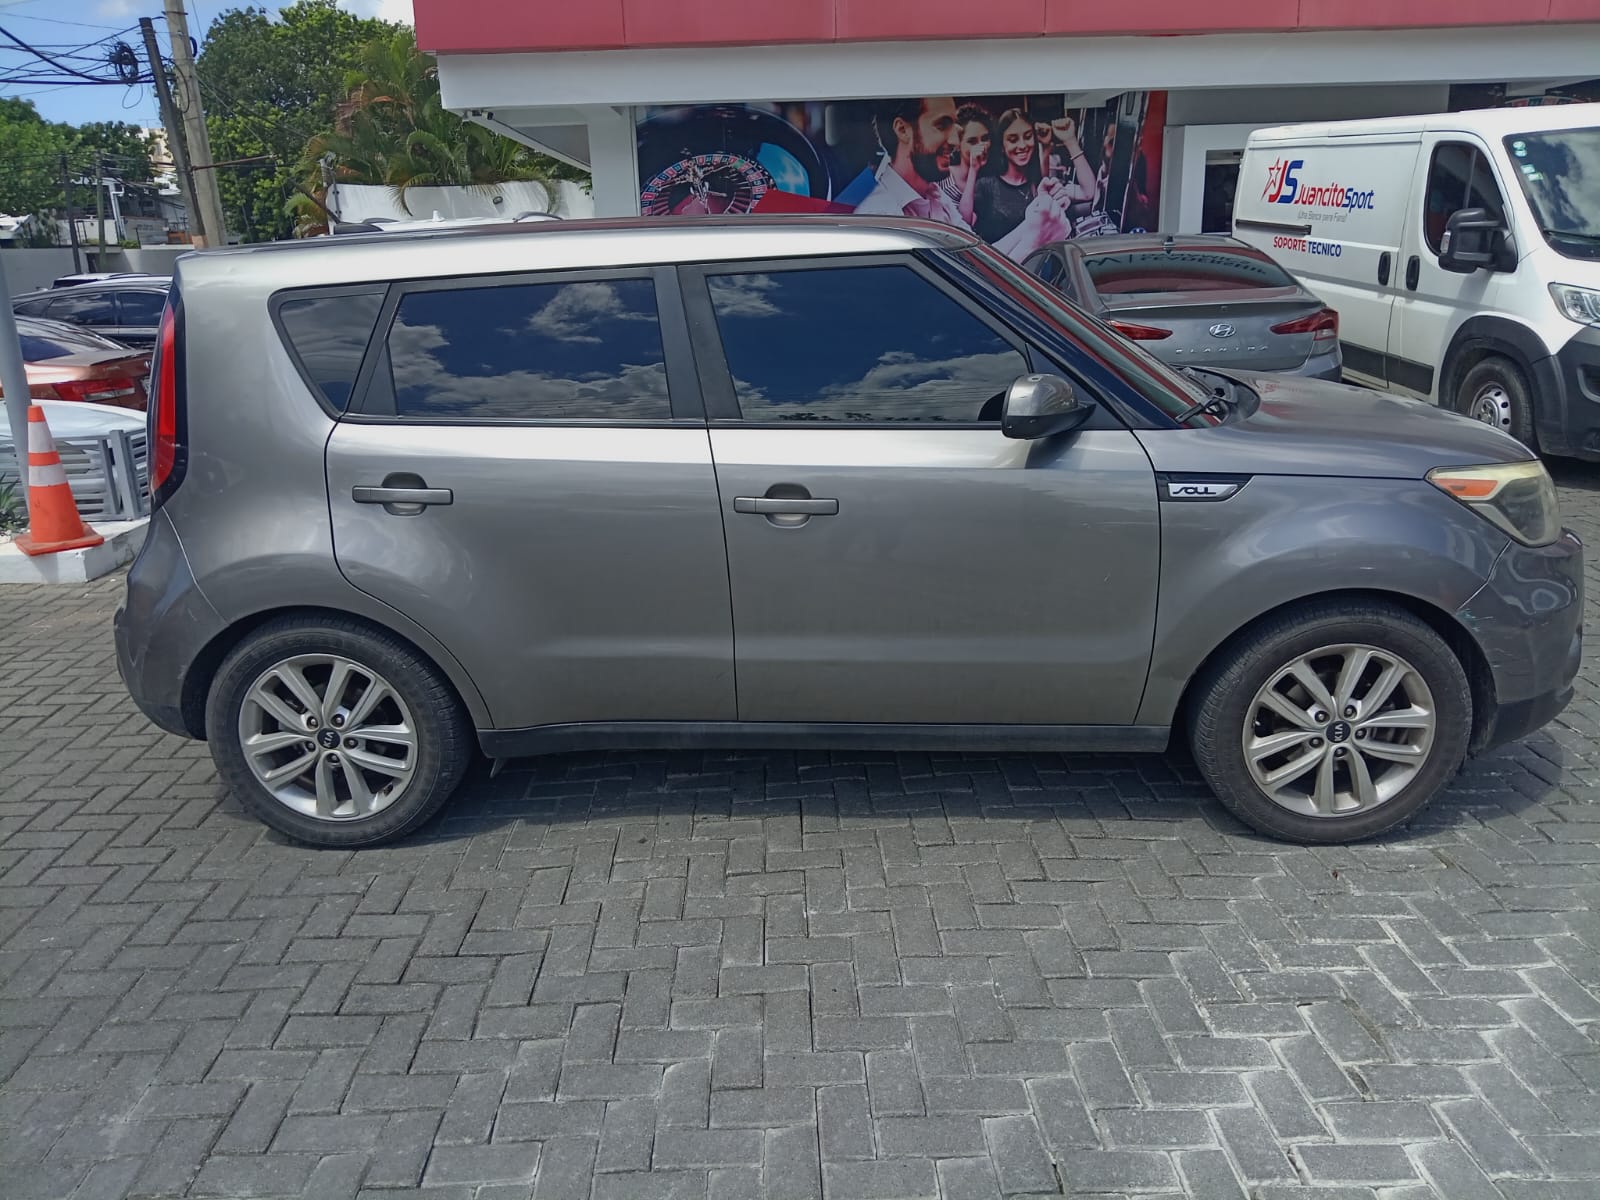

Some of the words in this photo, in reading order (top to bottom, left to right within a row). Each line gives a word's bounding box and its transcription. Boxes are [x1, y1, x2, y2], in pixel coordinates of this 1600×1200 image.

[1273, 236, 1306, 252] SOPORTE
[1308, 241, 1342, 257] TECNICO
[1172, 486, 1217, 495] SOUL
